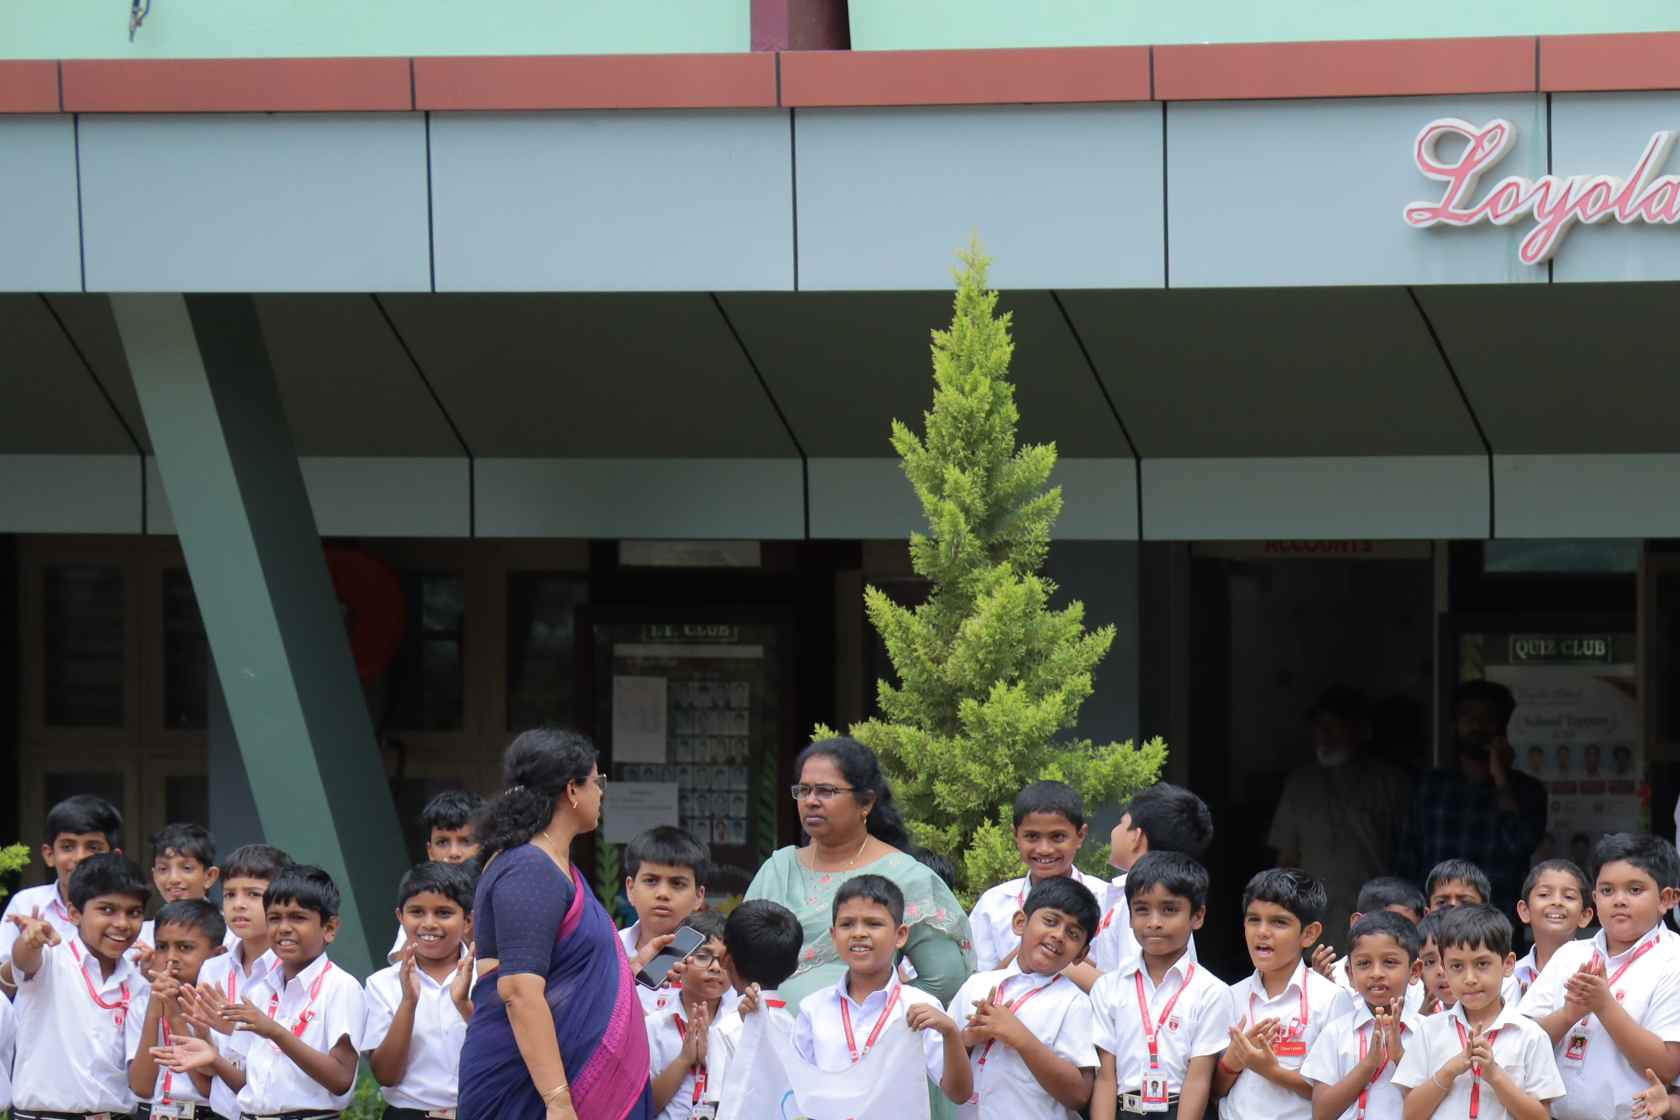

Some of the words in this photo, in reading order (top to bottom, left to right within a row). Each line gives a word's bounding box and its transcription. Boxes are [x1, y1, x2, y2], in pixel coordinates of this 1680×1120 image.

[683, 623, 730, 638] CLUB
[1515, 639, 1557, 660] QUIZ
[1560, 639, 1606, 657] CLUB
